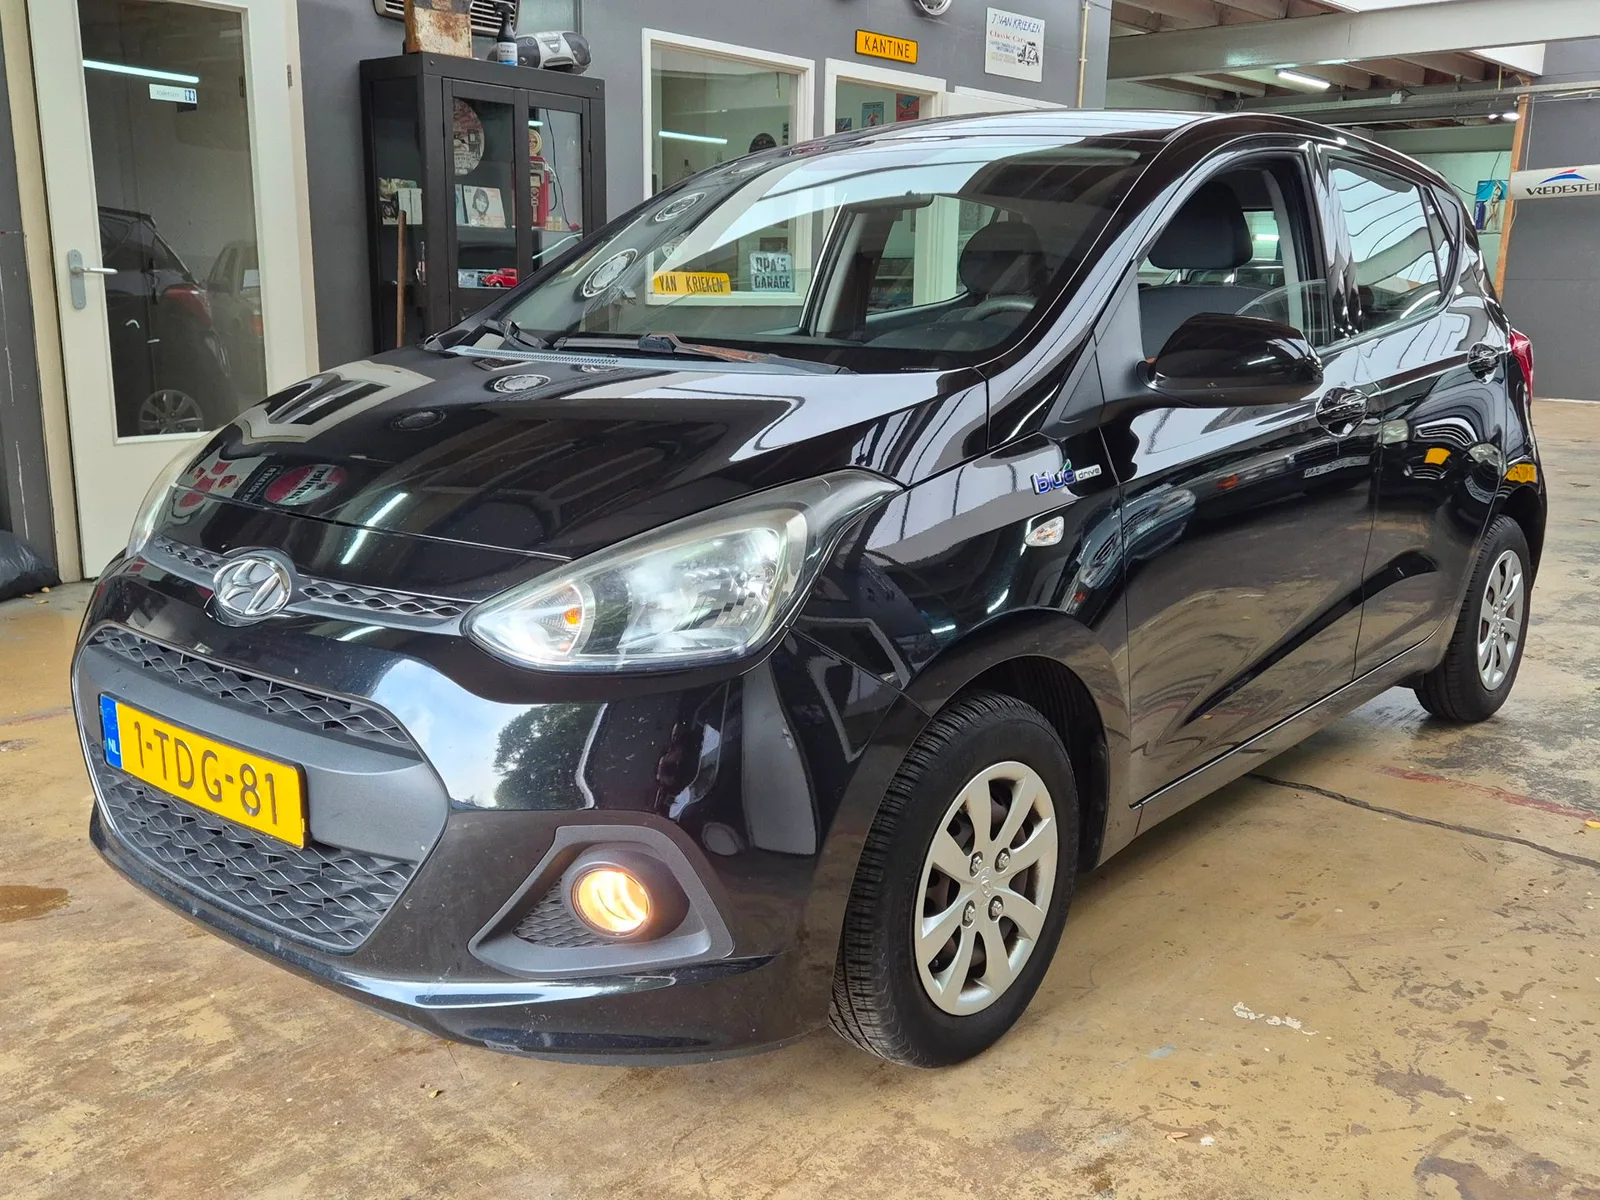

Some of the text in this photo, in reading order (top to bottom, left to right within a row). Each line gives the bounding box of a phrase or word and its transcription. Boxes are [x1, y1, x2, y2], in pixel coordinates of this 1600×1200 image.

[864, 35, 910, 58] KANTINE
[1526, 182, 1600, 195] VREDESTEI
[756, 256, 788, 273] OPA'S
[659, 275, 723, 293] VAN KRIEKEN
[754, 274, 790, 289] GARAGE
[1030, 463, 1101, 495] blue drive
[107, 737, 120, 755] NL
[134, 721, 278, 826] 1-TDG-81
